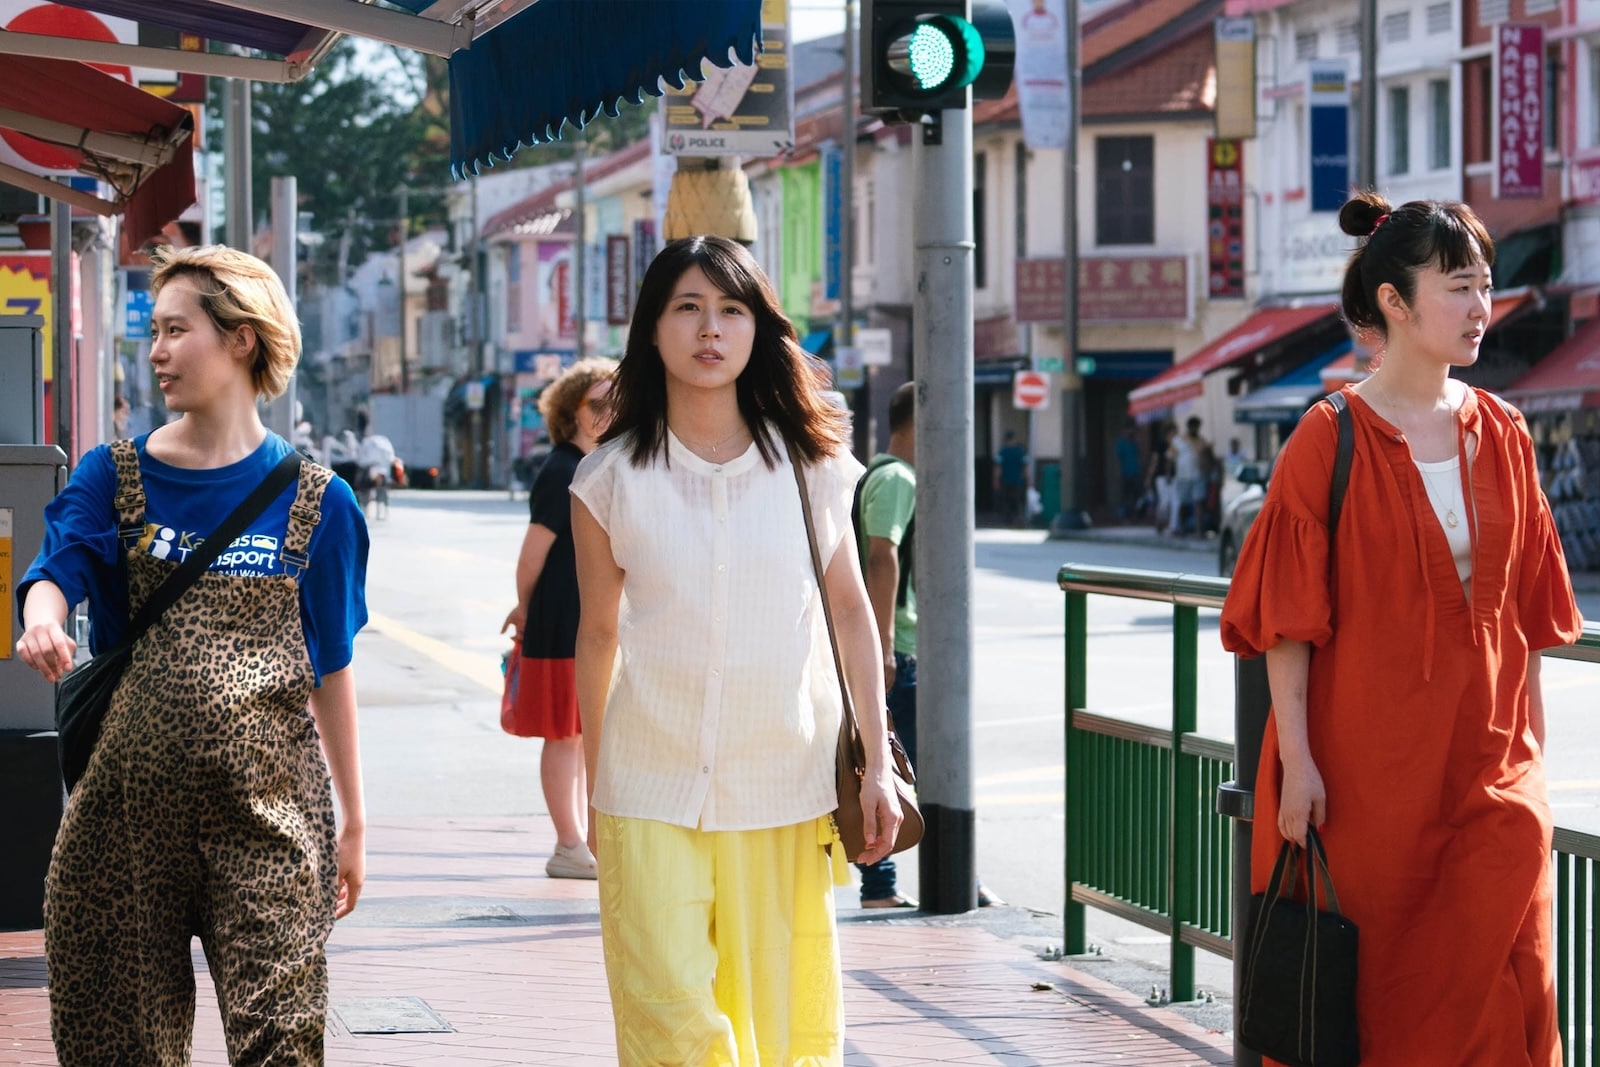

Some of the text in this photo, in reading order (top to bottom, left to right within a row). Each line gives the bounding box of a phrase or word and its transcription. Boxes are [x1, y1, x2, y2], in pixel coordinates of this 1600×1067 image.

[1502, 27, 1520, 185] NAKSHATRA
[1522, 54, 1539, 160] BEAUTY
[689, 138, 726, 148] POLICE
[179, 530, 251, 550] Kaas
[178, 546, 277, 570] Tnsport
